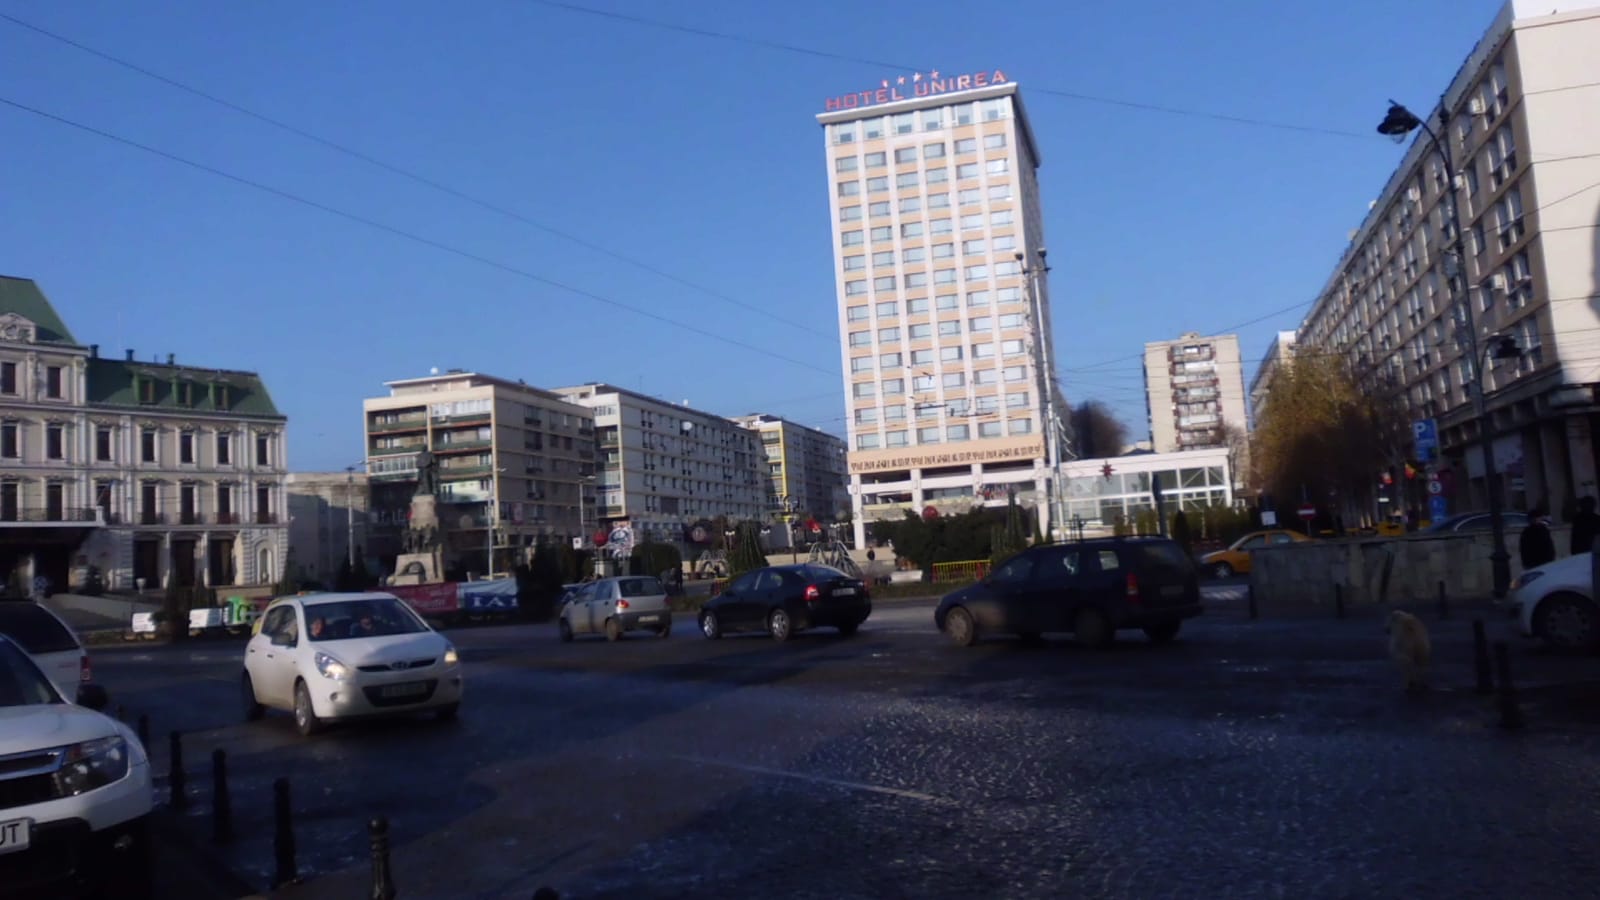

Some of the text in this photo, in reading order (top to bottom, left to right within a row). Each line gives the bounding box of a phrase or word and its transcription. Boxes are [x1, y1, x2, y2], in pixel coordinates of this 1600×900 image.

[825, 69, 1008, 111] HOTEL UNIREA
[1414, 422, 1426, 438] P
